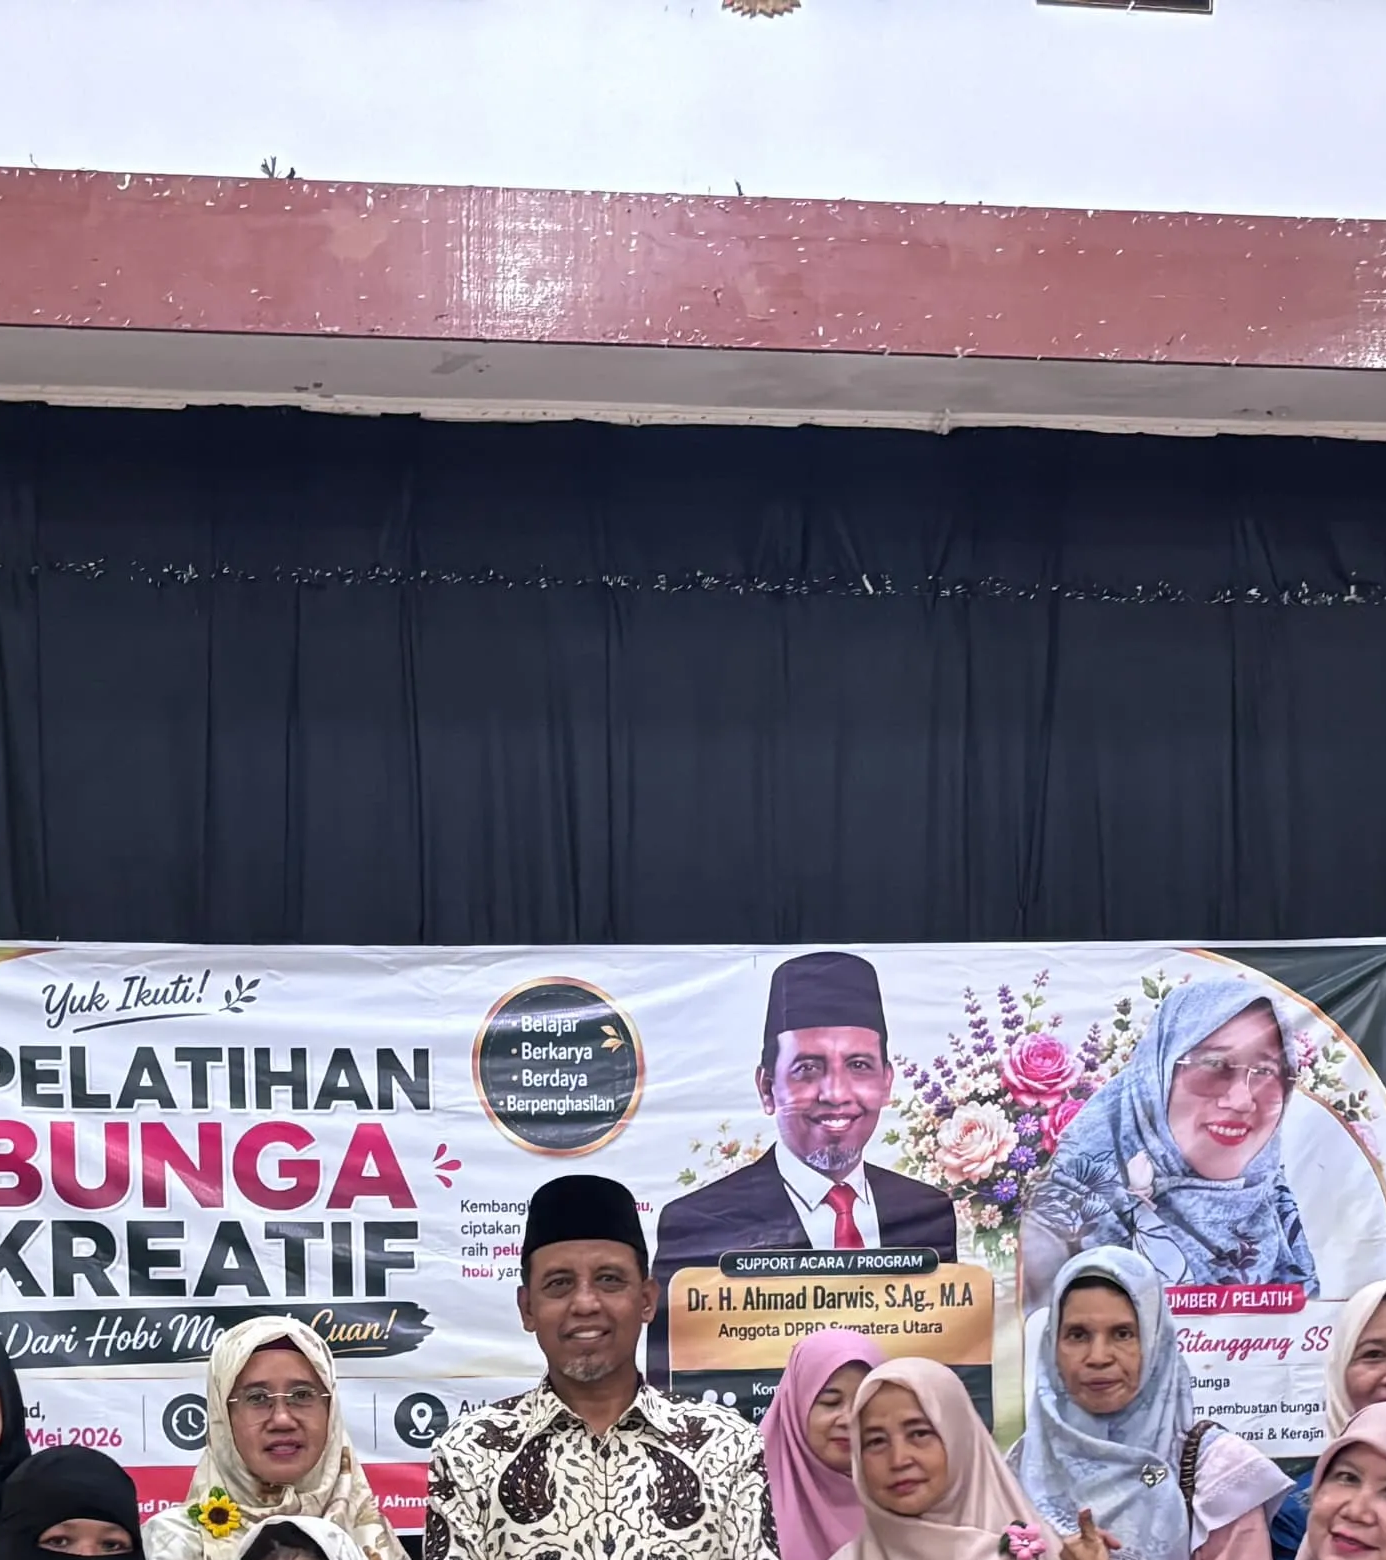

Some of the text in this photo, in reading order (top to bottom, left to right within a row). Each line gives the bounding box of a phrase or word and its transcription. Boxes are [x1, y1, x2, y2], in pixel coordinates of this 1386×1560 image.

[41, 968, 211, 1029] Yuk Ikuti!
[521, 1015, 579, 1036] Belajar
[521, 1042, 593, 1064] Berkarya
[522, 1068, 588, 1091] Berdaya
[507, 1095, 615, 1115] Berpenghasilan
[460, 1200, 530, 1216] Kembang
[460, 1220, 521, 1236] ciptakan
[461, 1243, 524, 1259] raih pelu
[462, 1264, 494, 1278] hobi
[736, 1255, 923, 1271] SUPPORT ACARA / PROGRAM
[687, 1287, 713, 1312] Dr.
[718, 1287, 737, 1311] H.
[742, 1286, 807, 1311] Ahmad
[813, 1285, 879, 1312] Darwis,
[939, 1282, 974, 1307] M.A
[1165, 1290, 1293, 1309] UMBER / PELATIH
[0, 1320, 79, 1360] Dari
[85, 1316, 162, 1358] Hobi
[311, 1308, 398, 1343] Cuan!
[718, 1323, 780, 1341] Anggota
[784, 1321, 826, 1337] DPRD
[903, 1320, 943, 1334] Utara
[1176, 1325, 1333, 1362] Sitanggang SS
[1208, 1402, 1278, 1417] pembuatan
[1280, 1401, 1320, 1415] bunga
[25, 1427, 123, 1448] Mei 2026
[1267, 1427, 1278, 1440] &
[1280, 1427, 1325, 1441] Kerajin
